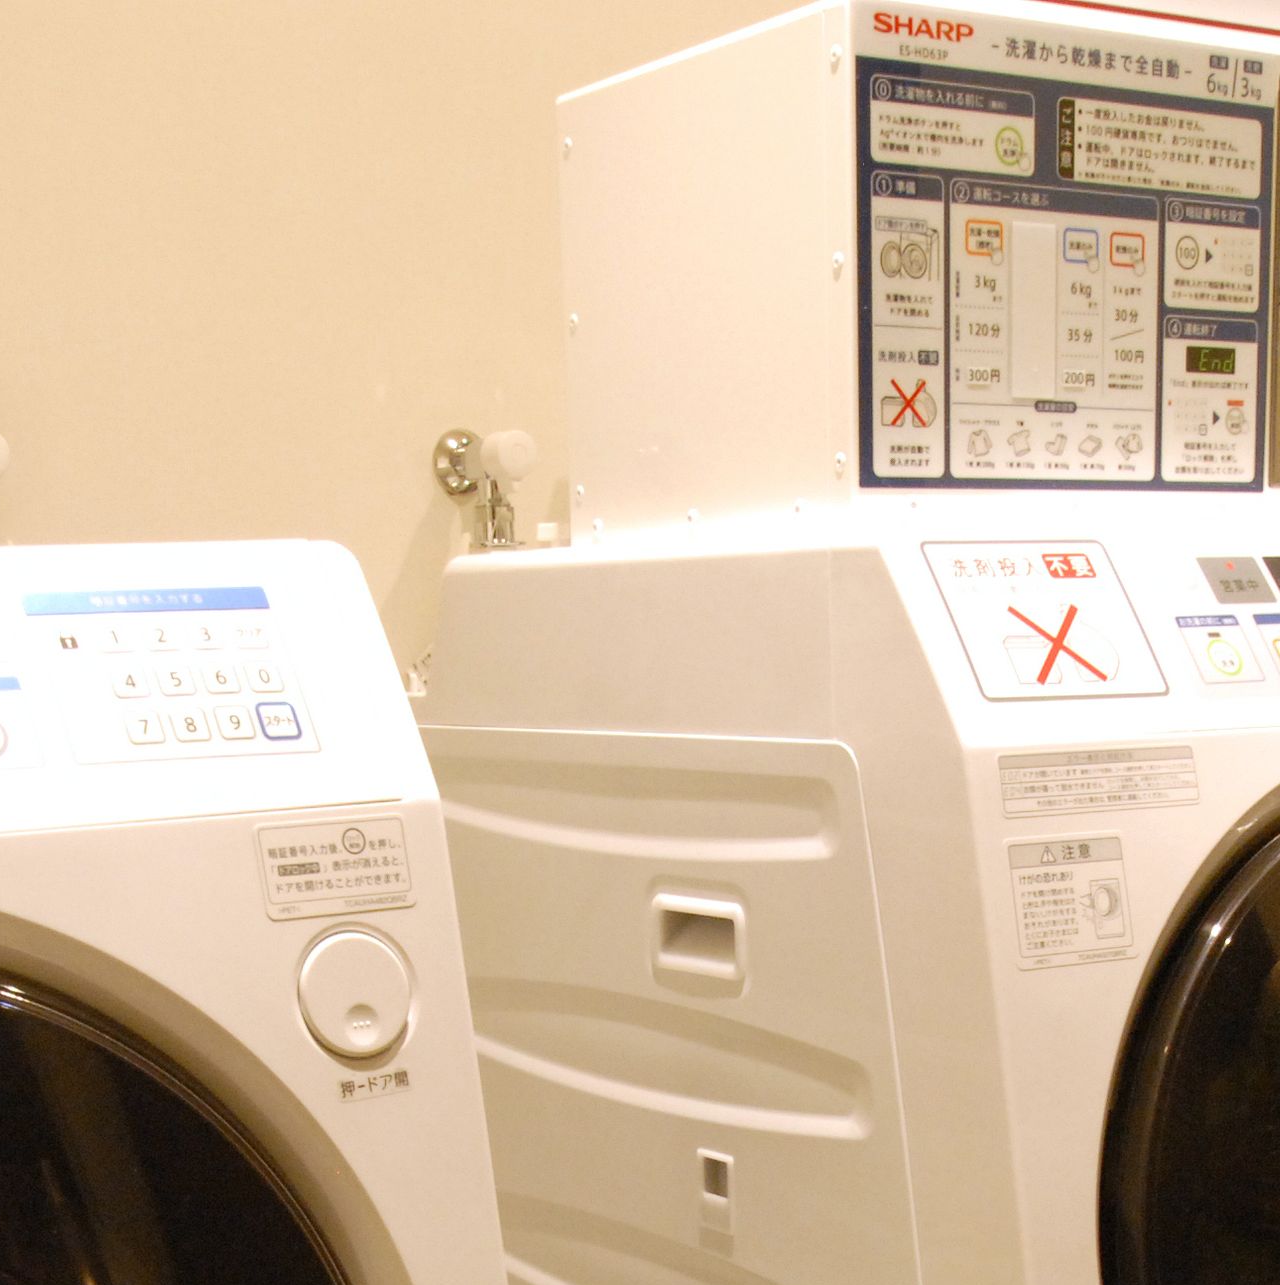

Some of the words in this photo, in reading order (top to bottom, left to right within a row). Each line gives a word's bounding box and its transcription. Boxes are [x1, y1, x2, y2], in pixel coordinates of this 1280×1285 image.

[873, 11, 975, 43] SHARP
[1199, 349, 1233, 372] End
[953, 557, 1041, 578] 洗剤投入
[1044, 555, 1094, 577] 不要
[155, 628, 168, 643] 2
[200, 627, 212, 642] 3
[125, 674, 137, 689] 4
[169, 672, 183, 688] 5
[215, 670, 228, 686] 6
[258, 669, 271, 685] 0
[138, 719, 150, 735] 7
[185, 717, 198, 733] 8
[229, 715, 241, 731] 9
